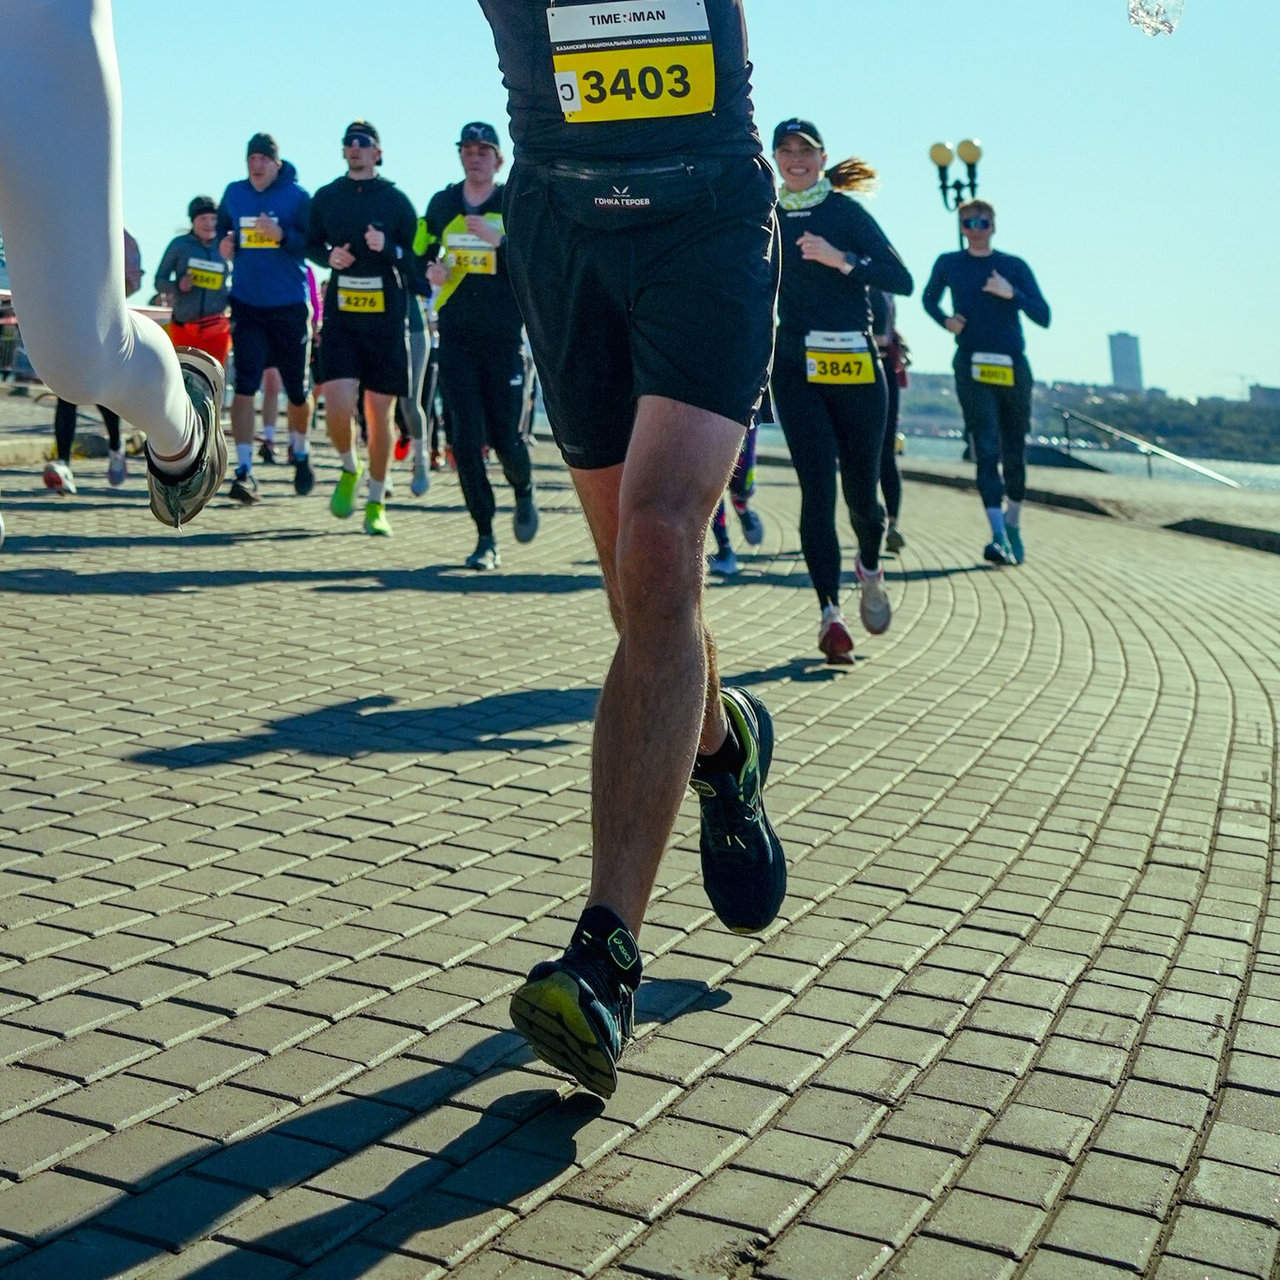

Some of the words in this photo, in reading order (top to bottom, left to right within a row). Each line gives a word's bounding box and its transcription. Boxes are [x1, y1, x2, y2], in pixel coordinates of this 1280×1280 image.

[556, 43, 587, 51] КАЗАНСКИЙ
[587, 39, 632, 48] НАЦИОНАЛЬНЫЙ
[633, 37, 675, 45] ПОЛУМАРАФОН
[582, 64, 691, 104] 3403
[594, 197, 620, 205] ГОНКА
[621, 198, 650, 206] ГЕРОЕВ
[345, 296, 377, 307] 4276
[818, 361, 863, 376] 3847
